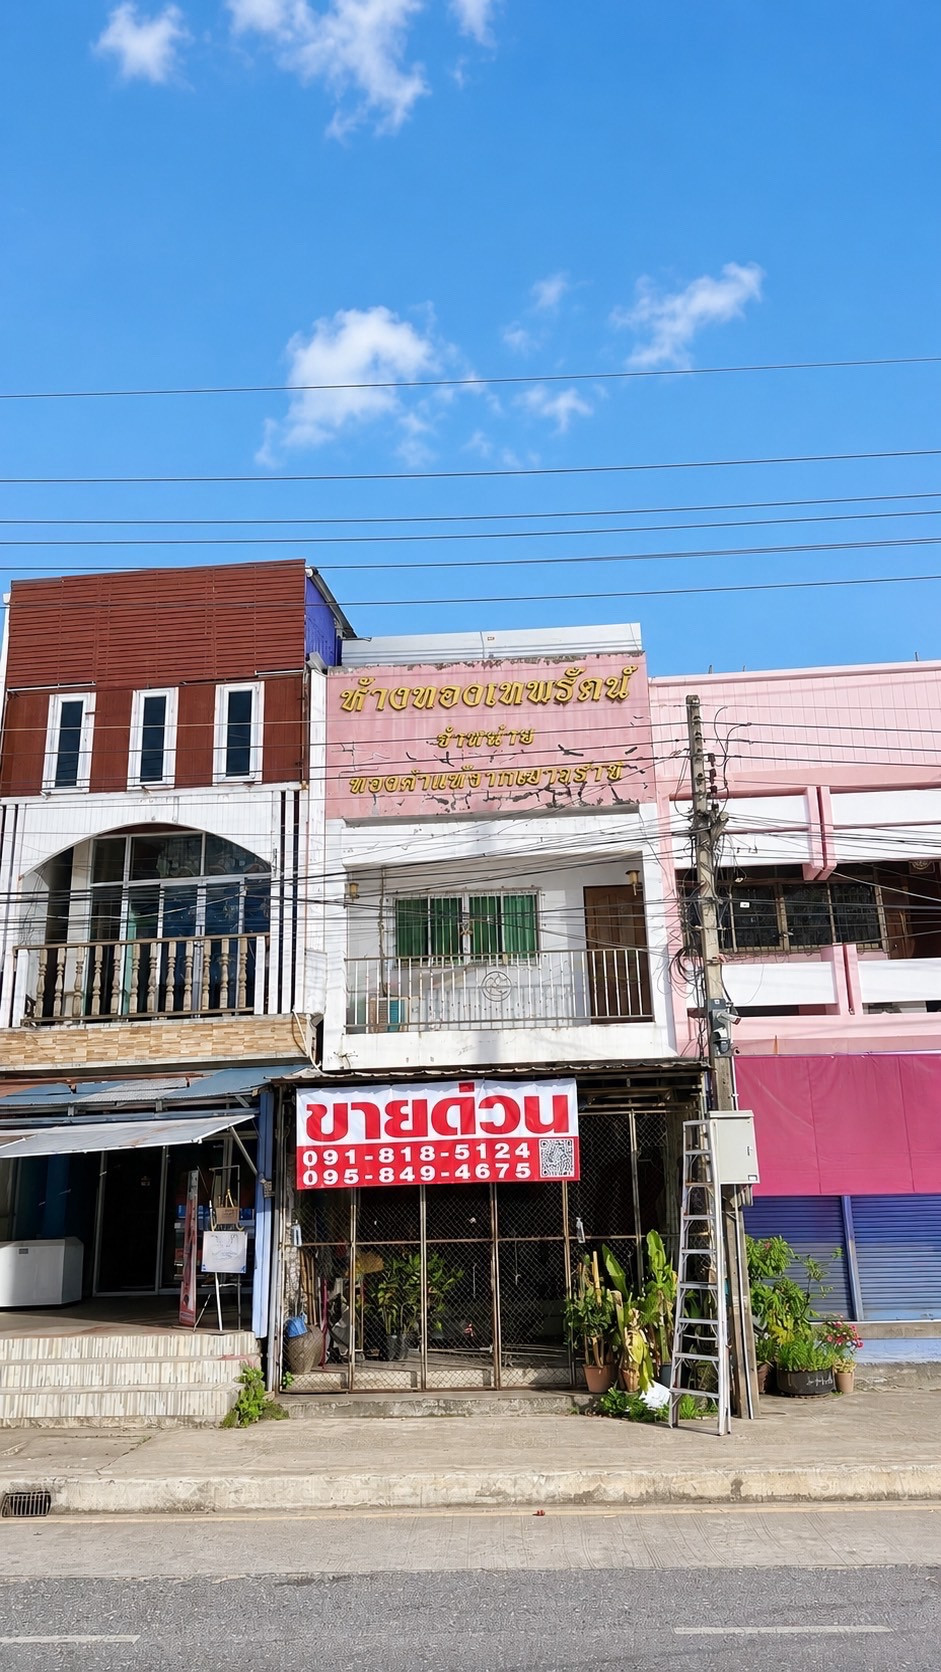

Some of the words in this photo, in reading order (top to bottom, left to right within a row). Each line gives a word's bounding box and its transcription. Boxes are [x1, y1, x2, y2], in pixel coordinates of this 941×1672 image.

[340, 664, 638, 712] ห้างทองเทพรัตน์
[306, 1082, 569, 1142] ขายด่วน
[302, 1142, 531, 1167] 091-818-5124
[302, 1162, 532, 1187] 095-849-4675
